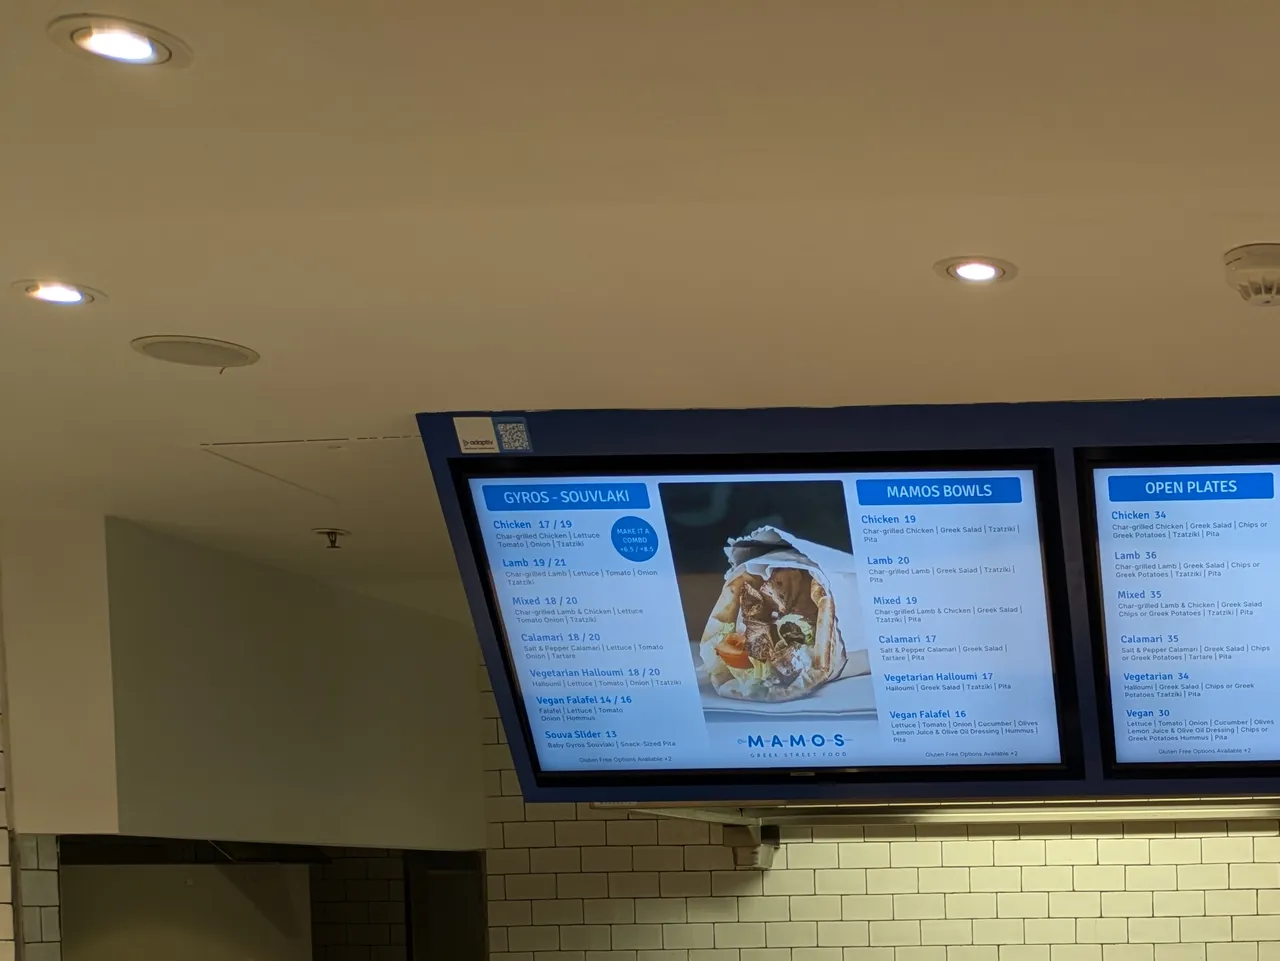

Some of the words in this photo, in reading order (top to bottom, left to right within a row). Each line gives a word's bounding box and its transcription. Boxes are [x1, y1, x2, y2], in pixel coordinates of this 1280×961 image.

[887, 485, 940, 498] MAMOS
[943, 484, 992, 497] BOWLS
[1145, 482, 1183, 494] OPEN
[1187, 480, 1237, 493] PLATES
[504, 491, 550, 504] GYROS
[560, 490, 630, 503] SOUVLAKI
[861, 515, 899, 524] Chicken
[904, 515, 916, 523] 19
[1112, 510, 1150, 520] Chicken
[1155, 511, 1166, 519] 34
[493, 520, 532, 529] Chicken
[539, 520, 550, 529] 17
[560, 520, 572, 528] 19
[867, 556, 893, 565] Lamb
[897, 556, 910, 565] 20
[1115, 551, 1141, 560] Lamb
[1145, 551, 1157, 560] 36
[502, 558, 529, 567] Lamb
[533, 558, 545, 567] 19
[554, 558, 567, 567] 21
[1118, 590, 1146, 599] Mixed
[1150, 591, 1162, 599] 35
[512, 596, 541, 605] Mixed
[545, 597, 557, 605] 18
[566, 597, 578, 605] 20
[873, 596, 901, 605] Mixed
[906, 596, 918, 605] 19
[521, 633, 564, 642] Calamari
[568, 633, 580, 641] 18
[588, 633, 601, 641] 20
[878, 635, 921, 644] Calamari
[925, 635, 936, 643] 17
[1121, 634, 1163, 644] Calamari
[1168, 635, 1179, 643] 35
[529, 669, 580, 680] Vegetarian
[581, 668, 624, 677] Halloumi
[628, 668, 640, 677] 18
[648, 668, 660, 676] 20
[884, 673, 934, 684] Vegetarian
[936, 672, 978, 681] Halloumi
[1123, 672, 1173, 683] Vegetarian
[536, 696, 565, 706] Vegan
[566, 696, 598, 704] Falafel
[600, 696, 612, 704] 14
[620, 696, 632, 704] 16
[889, 711, 917, 721] Vegan
[919, 710, 951, 718] Falafel
[955, 710, 967, 718] 16
[1126, 709, 1154, 719] Vegan
[1159, 709, 1170, 717] 30
[545, 731, 573, 739] Souva
[574, 730, 601, 739] Slider
[747, 734, 845, 748] MAMOS
